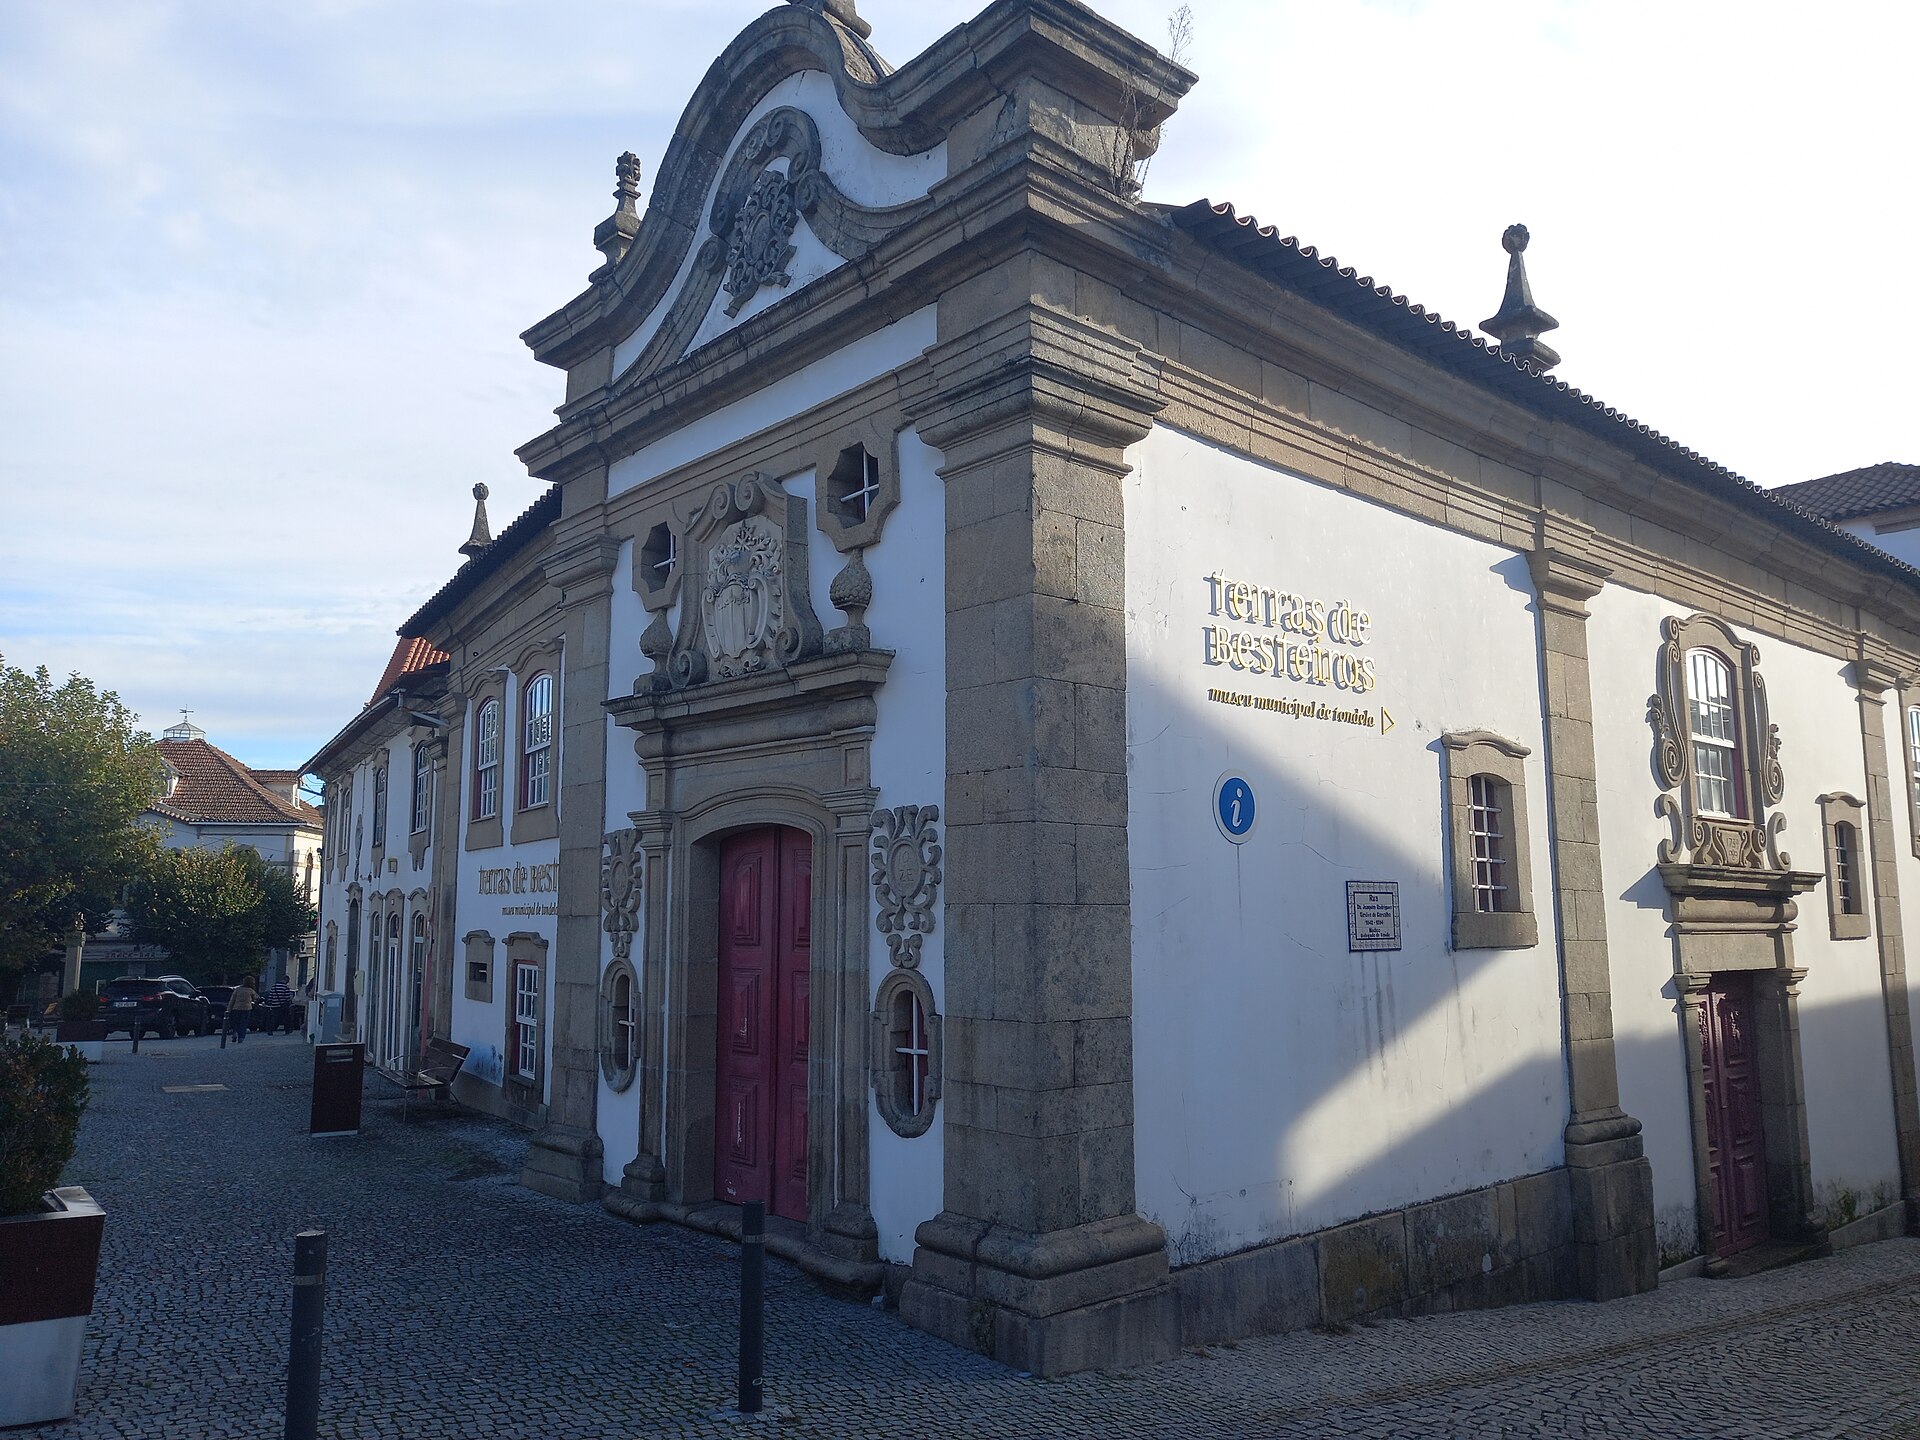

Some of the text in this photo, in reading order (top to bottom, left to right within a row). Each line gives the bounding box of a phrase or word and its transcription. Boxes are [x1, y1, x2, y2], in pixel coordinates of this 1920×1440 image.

[1204, 570, 1372, 647] terras de
[1203, 624, 1376, 693] Besteiros
[1207, 688, 1375, 727] museu municipal de tondela
[478, 857, 559, 895] terras de Best
